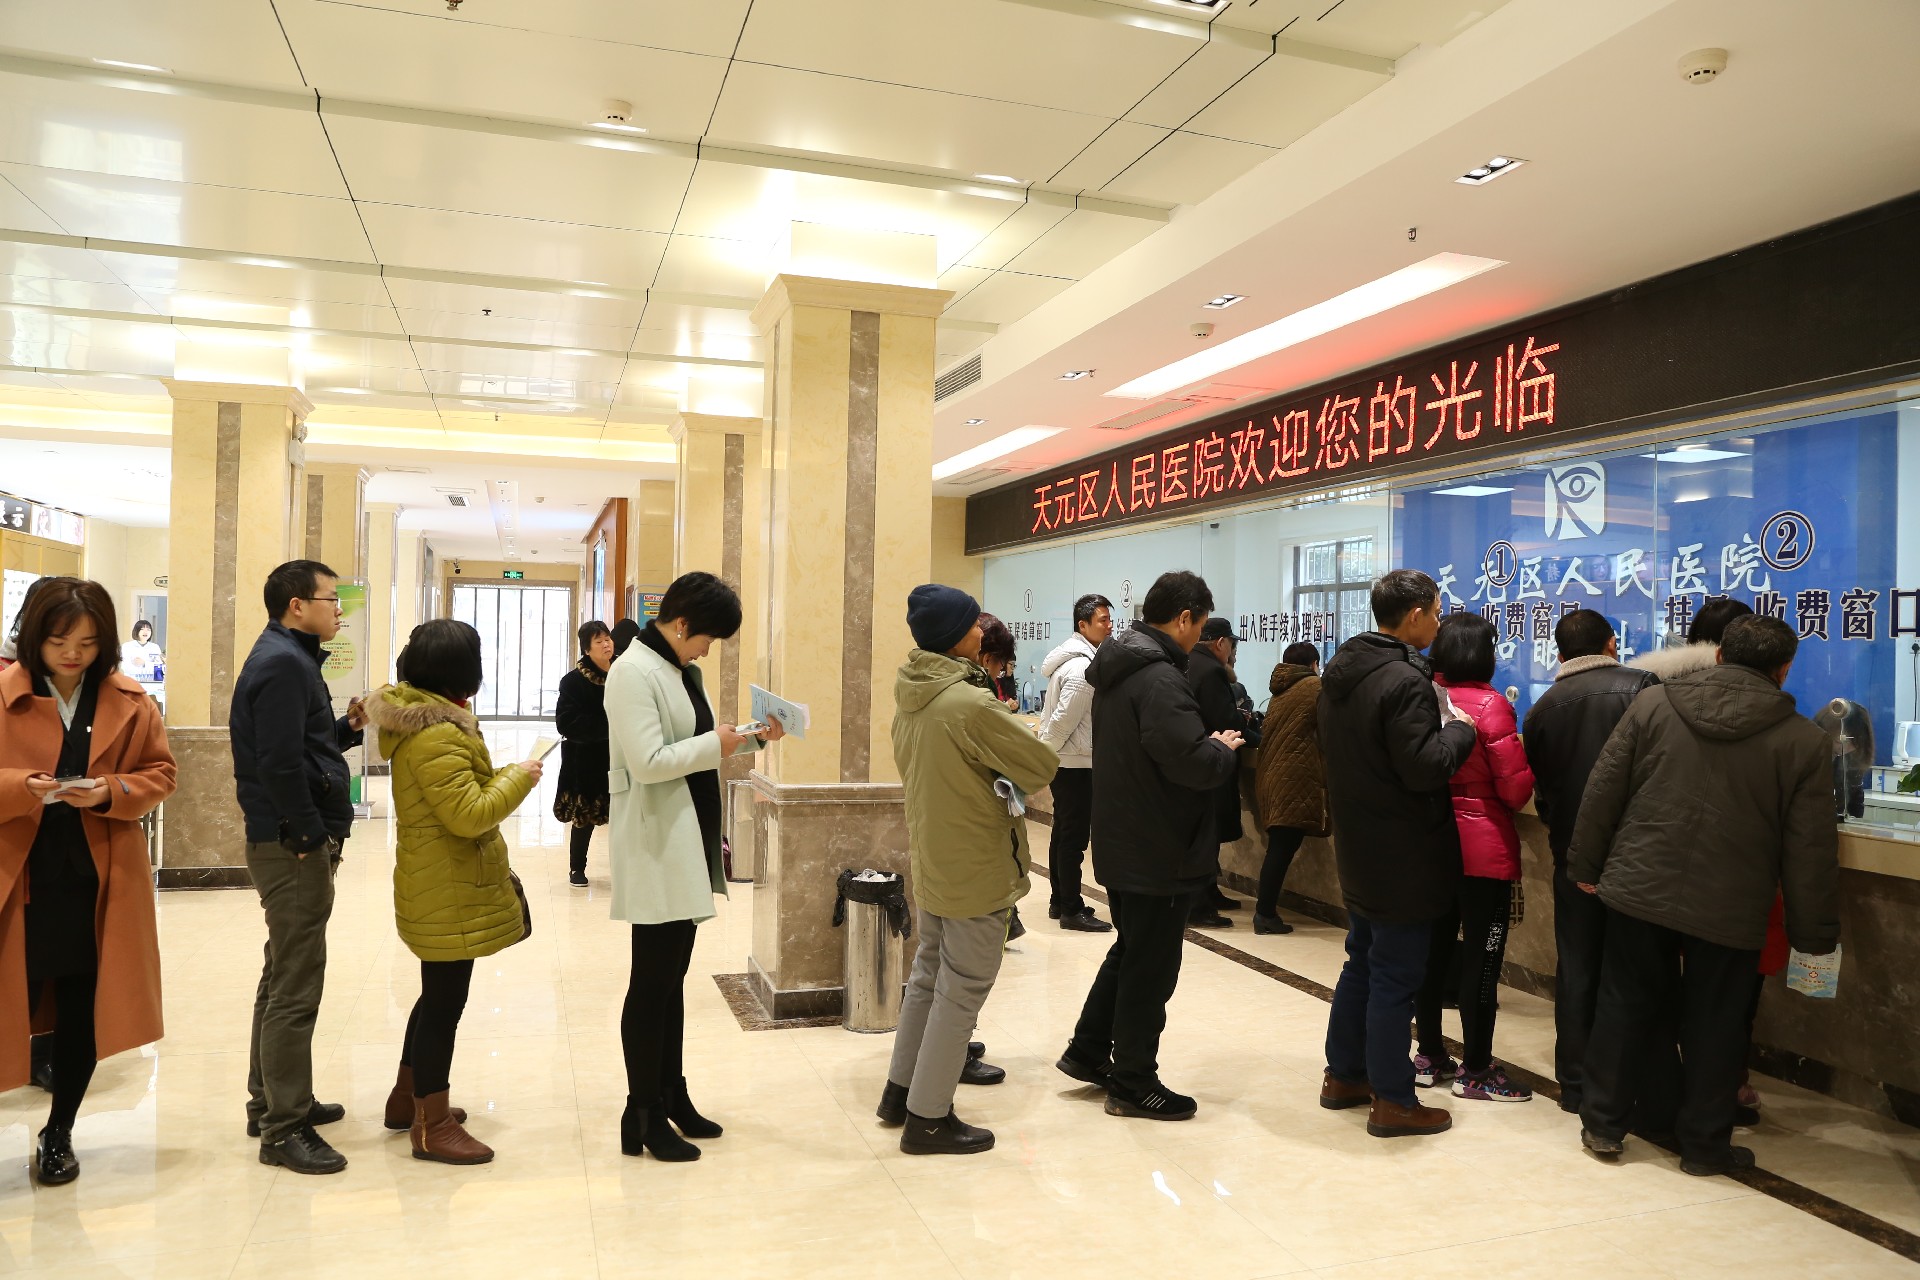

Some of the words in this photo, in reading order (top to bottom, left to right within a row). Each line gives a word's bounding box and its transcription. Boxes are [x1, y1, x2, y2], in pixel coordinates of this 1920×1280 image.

[1032, 336, 1560, 534] 天元区人民医院欢迎您的光临
[1437, 533, 1771, 604] 天元区人民医院
[1240, 612, 1335, 642] 出入院手续办理窗口
